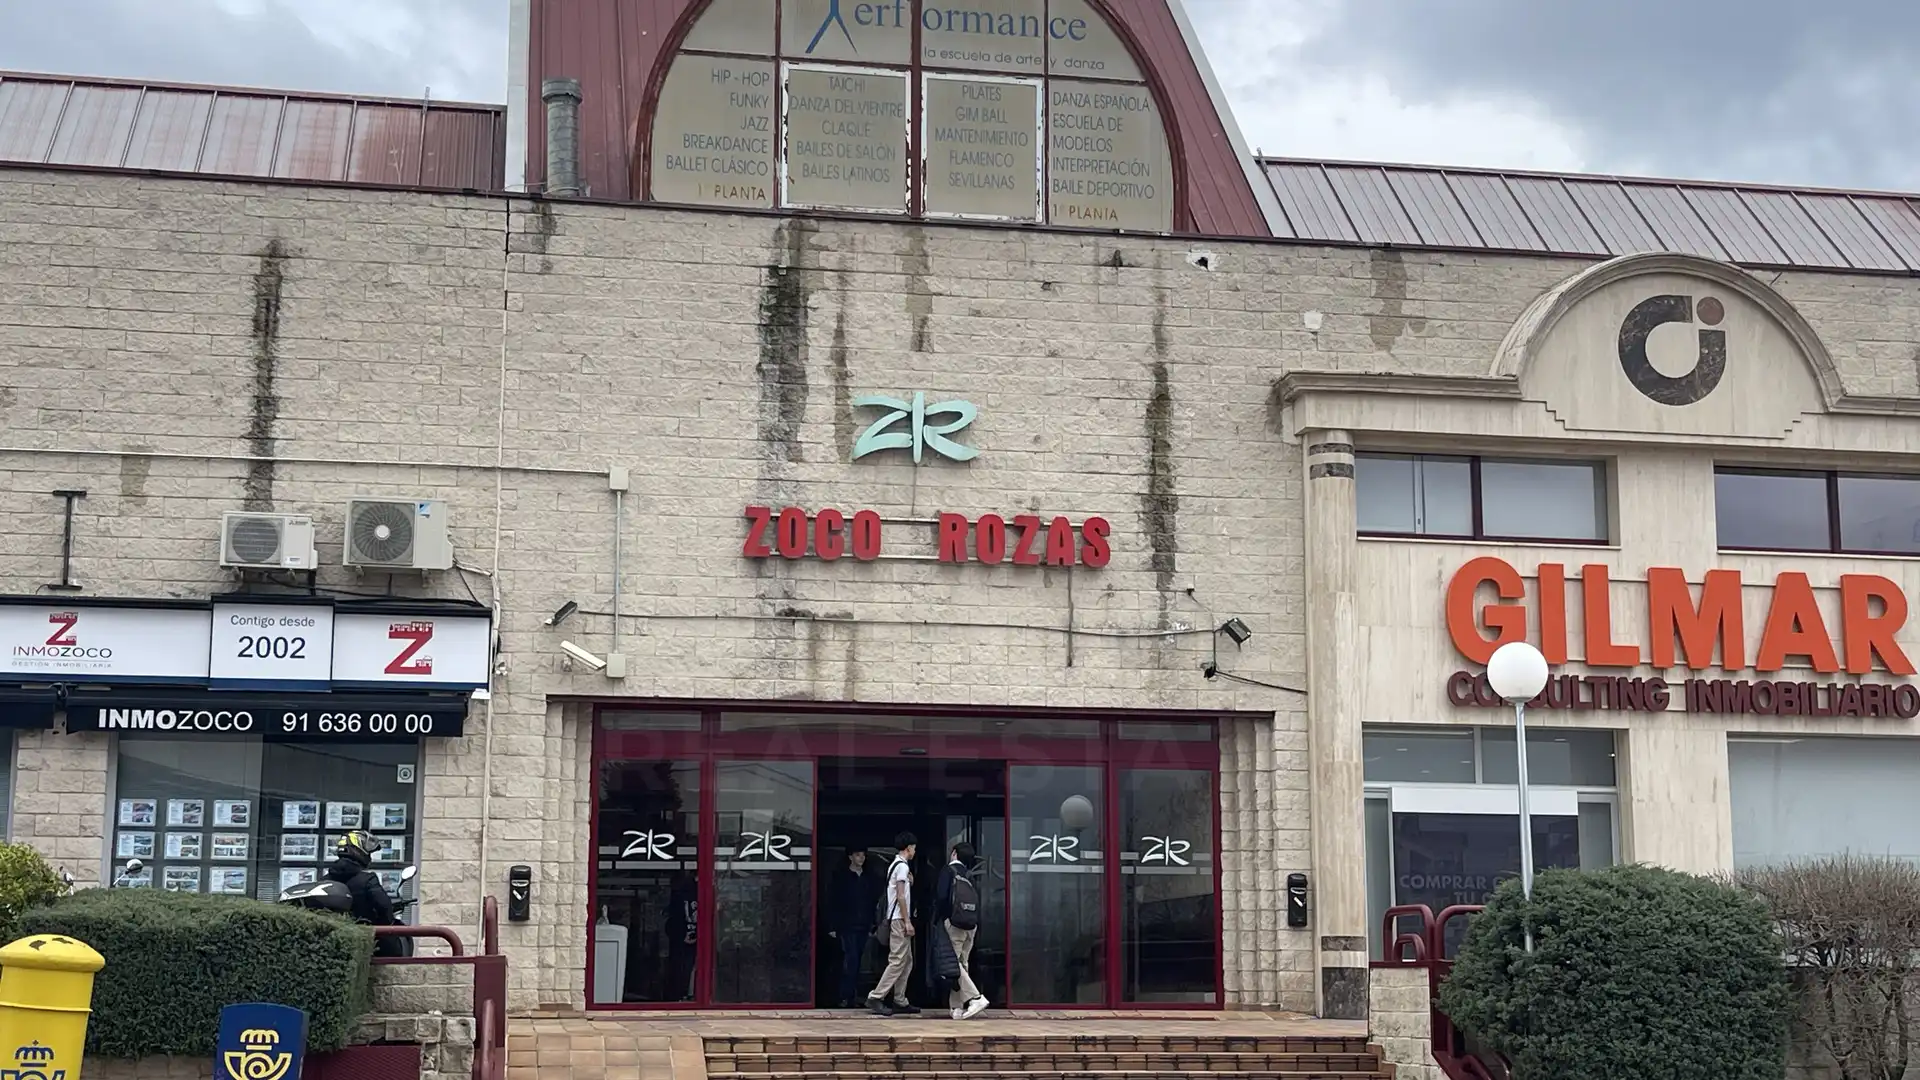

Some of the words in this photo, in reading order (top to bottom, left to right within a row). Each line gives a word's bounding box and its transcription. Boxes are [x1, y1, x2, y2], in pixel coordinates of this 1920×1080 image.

[923, 46, 937, 58] la
[939, 50, 991, 62] escuela
[994, 51, 1012, 63] de
[1015, 54, 1043, 66] arte
[1049, 58, 1058, 68] y
[1063, 57, 1106, 70] danza
[827, 76, 867, 93] TAICHI
[961, 84, 1002, 101] PILATES
[729, 92, 769, 109] FUNKY
[788, 95, 831, 113] DANZA
[834, 98, 857, 115] DEL
[857, 100, 905, 119] VIENTRE
[1053, 91, 1092, 109] DANZA
[1094, 93, 1151, 112] ESPAÑOLA
[740, 114, 769, 132] JAZZ
[955, 106, 979, 122] GIM
[981, 107, 1009, 124] BALL
[1053, 112, 1105, 131] ESCUELA
[1107, 116, 1124, 132] DE
[683, 133, 769, 154] BREAKDANCE
[934, 127, 1028, 147] MANTENIMIENTO
[1053, 134, 1114, 153] MODELOS
[796, 140, 834, 158] BAILES
[836, 142, 854, 159] DE
[949, 149, 1014, 168] FLAMENCO
[666, 154, 708, 172] BALLET
[711, 155, 769, 176] CLÁSICO
[802, 162, 840, 179] BAILES
[842, 164, 890, 183] LATINOS
[1053, 156, 1150, 177] INTERPRETACIÓN
[948, 171, 1015, 190] SEVILLANAS
[1052, 178, 1084, 195] BAILE
[1087, 180, 1155, 199] DEPORTIVO
[714, 184, 767, 201] PLANTA
[743, 506, 882, 561] ZOCO
[938, 511, 1111, 568] ROZAS
[230, 614, 275, 628] Contigo
[279, 616, 315, 628] desde
[1446, 556, 1918, 675] GILMAR
[13, 645, 113, 659] INMOZOCO
[237, 636, 306, 659] 2002
[1447, 670, 1670, 712] COULTING
[1684, 678, 1920, 719] INMOBILIARIO
[98, 708, 254, 731] INMOZOCO
[282, 711, 309, 732] 91
[318, 712, 362, 733] 636
[369, 713, 398, 733] 00
[404, 714, 433, 734] 00
[1399, 873, 1488, 890] COMPRAR
